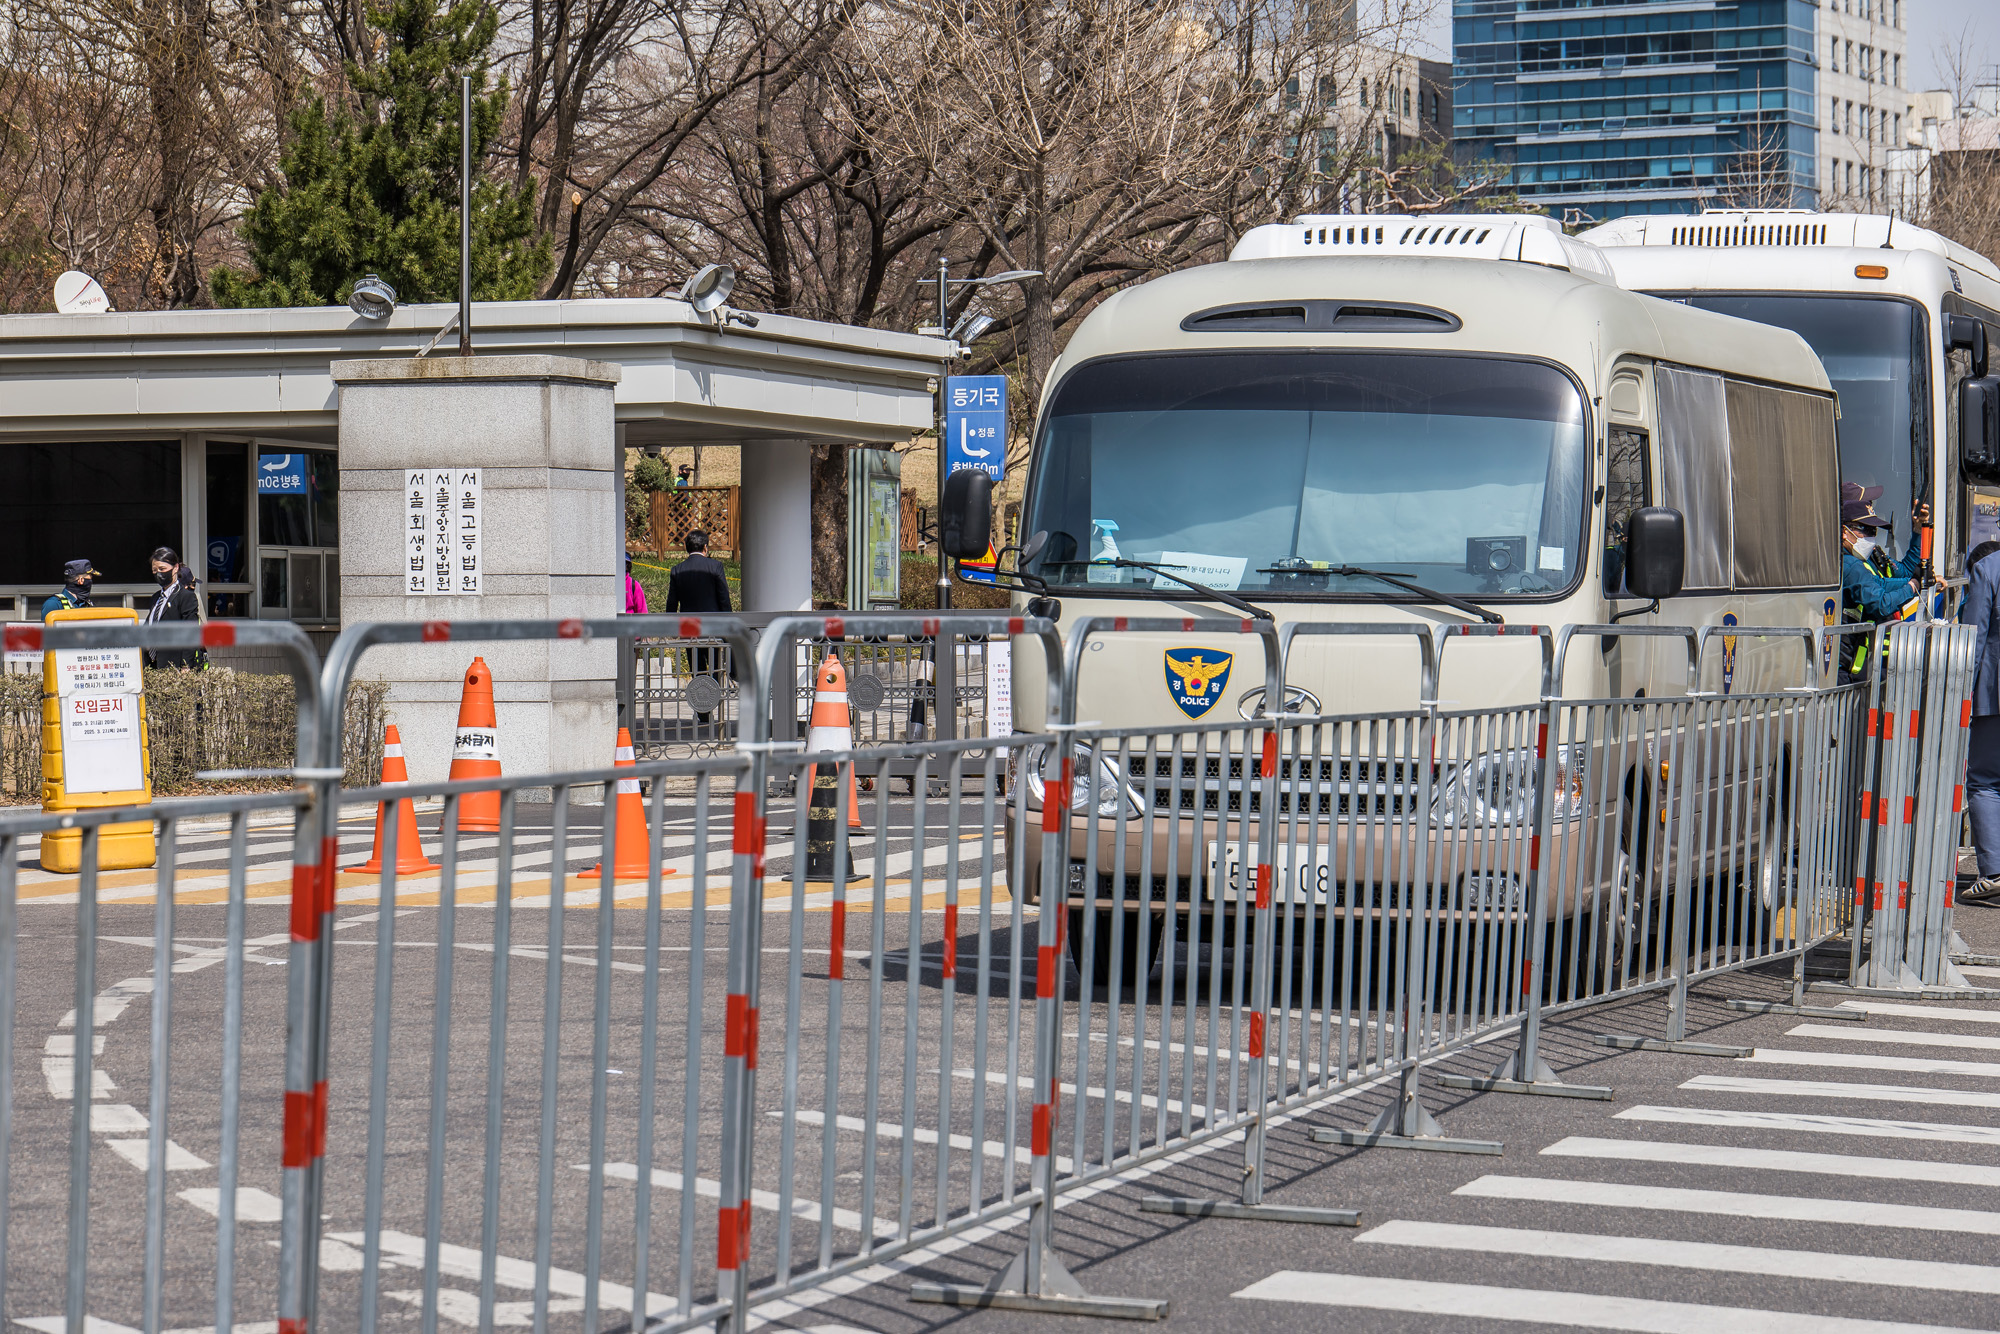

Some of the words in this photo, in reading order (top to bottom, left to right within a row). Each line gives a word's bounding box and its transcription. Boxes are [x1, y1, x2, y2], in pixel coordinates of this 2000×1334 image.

[953, 388, 999, 407] 등기국
[977, 427, 996, 438] 정문
[409, 473, 425, 592] 서울회생법원
[435, 473, 450, 592] 서울중앙지방법원
[461, 472, 477, 592] 서울고등법원
[1172, 680, 1181, 691] 경
[1211, 682, 1221, 693] 찰
[74, 698, 123, 714] 진입금지
[1180, 696, 1210, 706] POLICE
